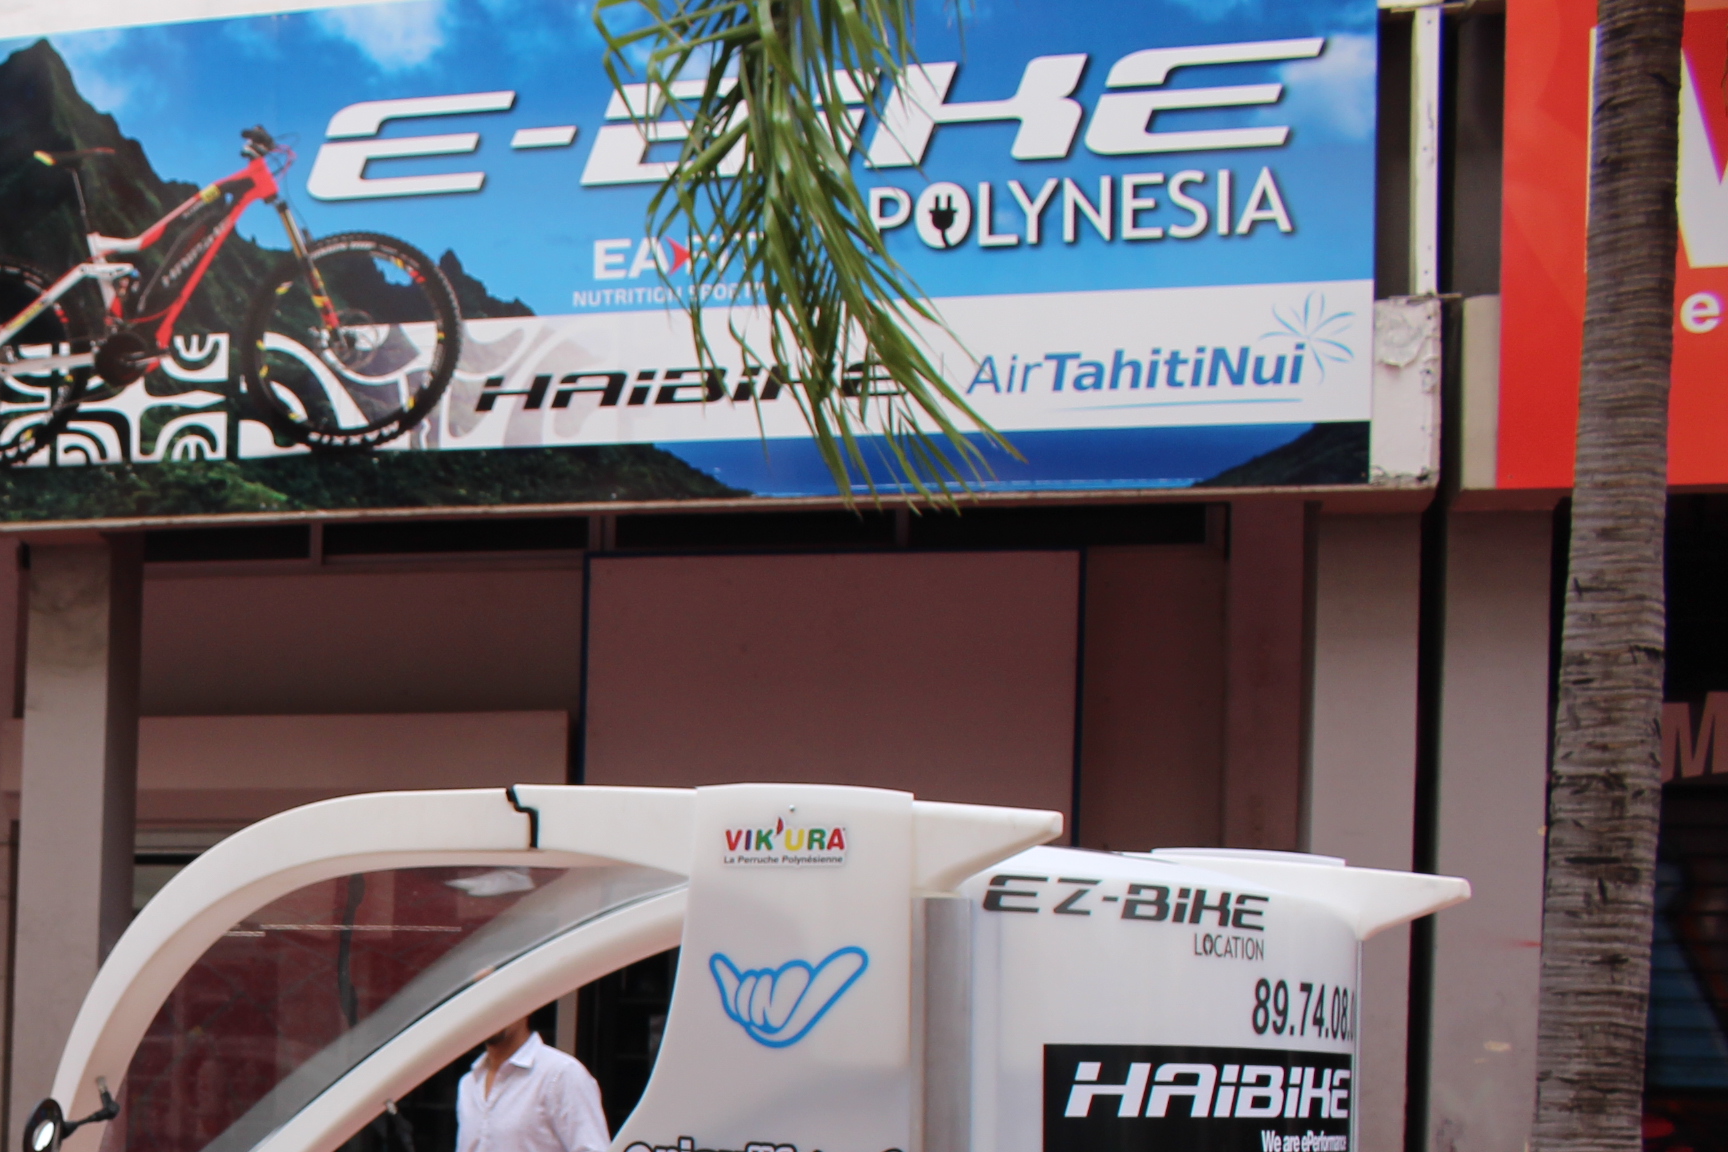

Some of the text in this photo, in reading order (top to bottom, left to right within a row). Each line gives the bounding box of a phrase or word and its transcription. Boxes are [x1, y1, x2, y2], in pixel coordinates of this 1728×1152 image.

[870, 167, 1294, 249] POLYNESIA
[965, 337, 1306, 396] AirTahitiNui
[723, 855, 844, 866] La Perruche Polynésienne
[724, 816, 845, 852] VIK'URA
[982, 873, 1270, 931] EZ-BIKE
[1193, 932, 1265, 962] LOCATION
[1064, 1061, 1352, 1120] HAIBIKE
